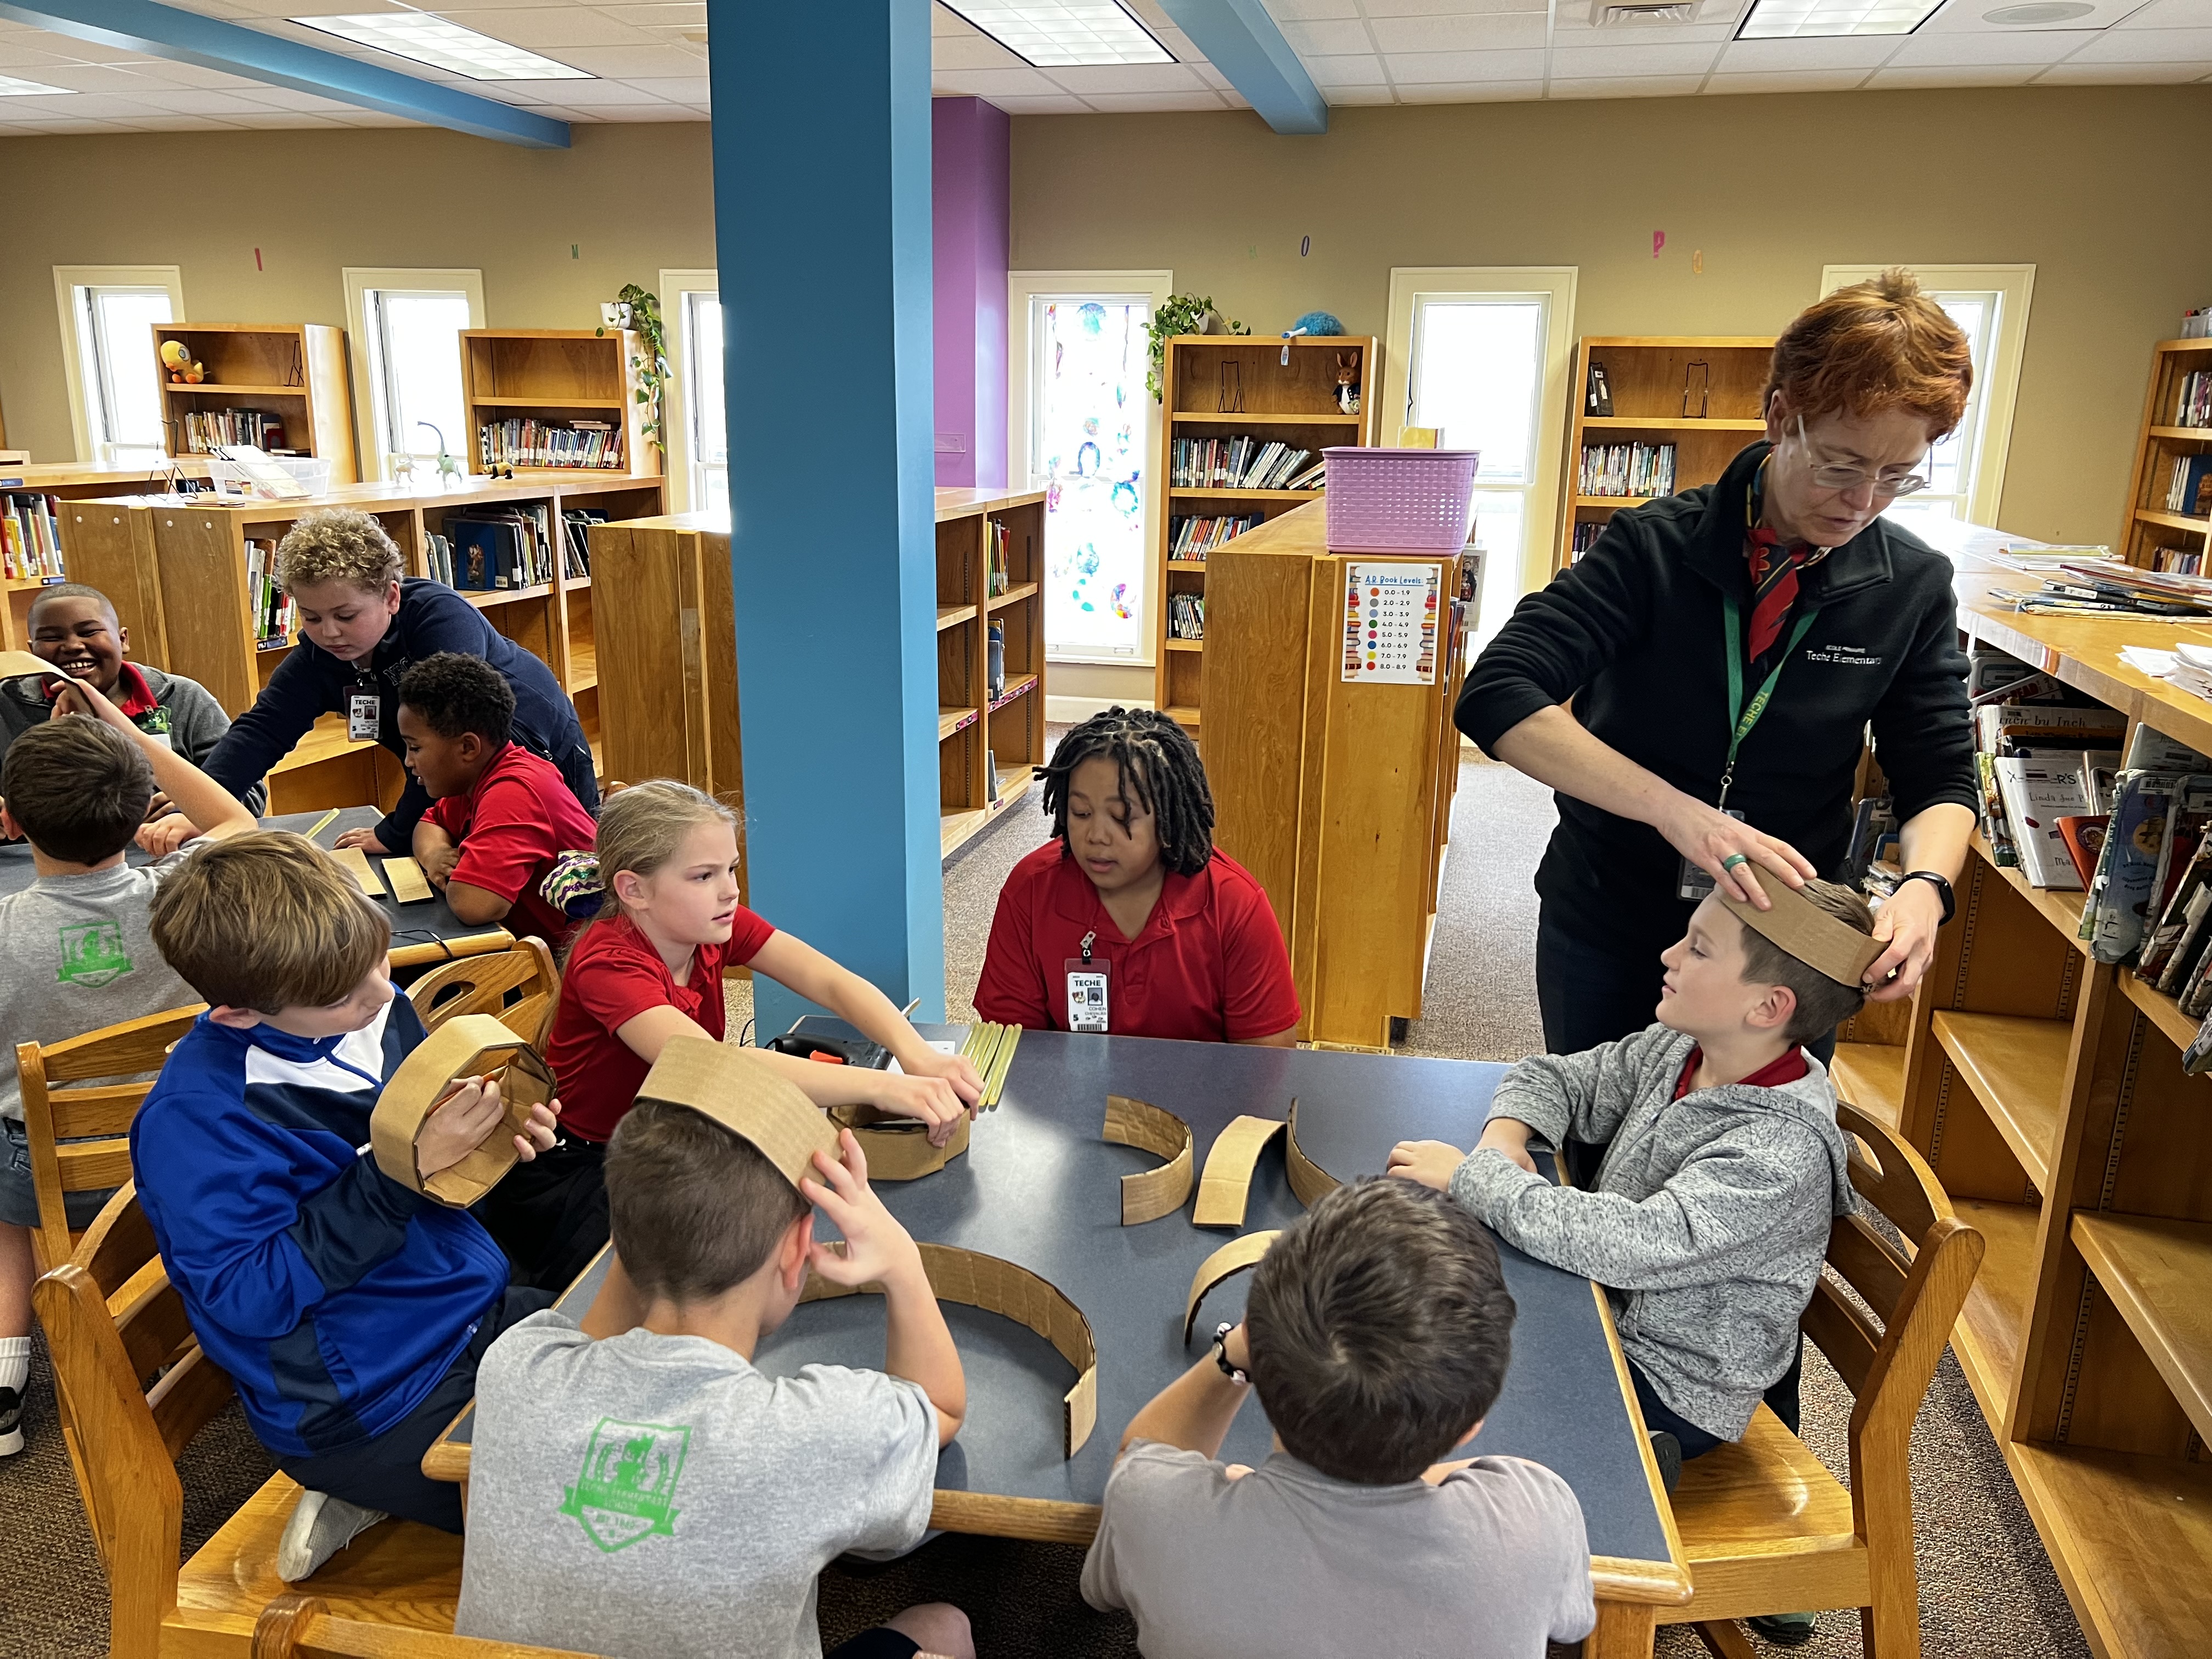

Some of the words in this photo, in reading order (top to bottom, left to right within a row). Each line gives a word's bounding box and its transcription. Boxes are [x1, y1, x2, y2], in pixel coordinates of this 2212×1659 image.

[1380, 575, 1398, 584] Book
[1806, 650, 1831, 662] Teche
[1742, 691, 1769, 725] TECHE
[2057, 716, 2086, 727] Inch
[2029, 793, 2056, 802] Linda
